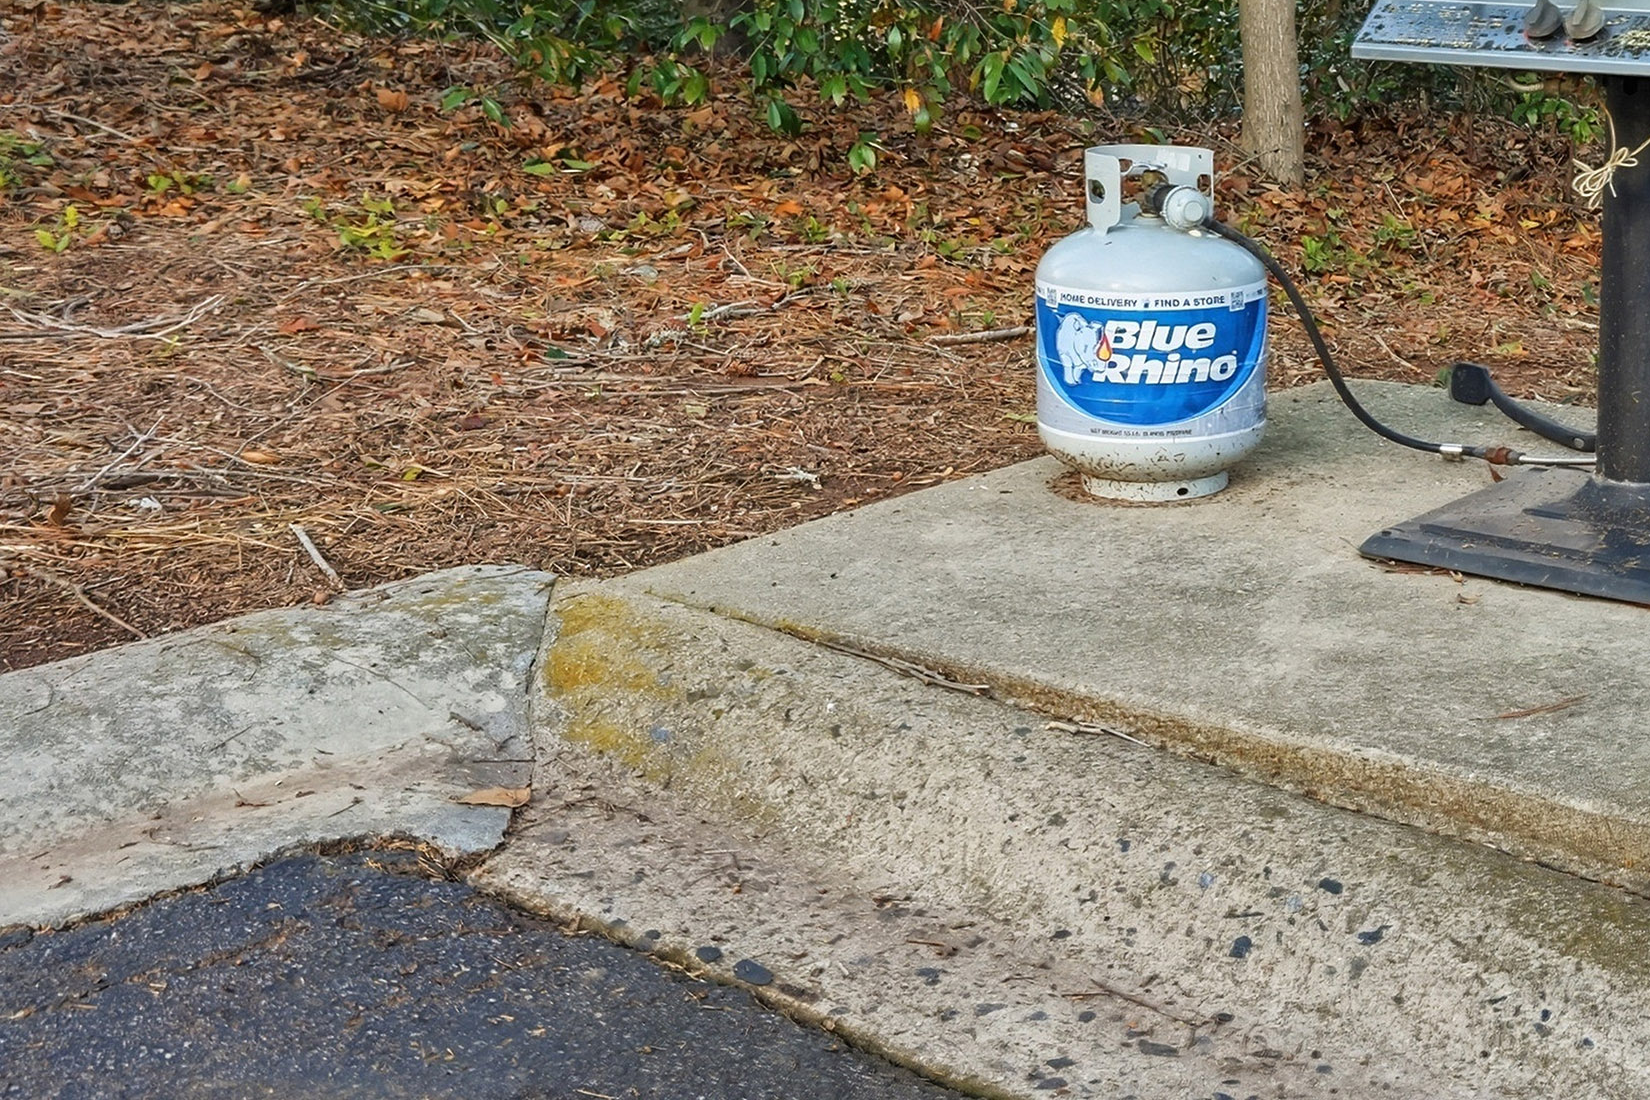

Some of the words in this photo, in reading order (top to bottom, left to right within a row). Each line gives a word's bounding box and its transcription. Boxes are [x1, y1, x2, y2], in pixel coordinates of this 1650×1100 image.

[1060, 292, 1085, 304] HOME
[1087, 296, 1138, 308] DELIVERY
[1154, 299, 1180, 308] FIND
[1183, 298, 1191, 307] A
[1193, 295, 1226, 306] STORE
[1104, 320, 1217, 352] Blue
[1092, 352, 1238, 385] Rhino
